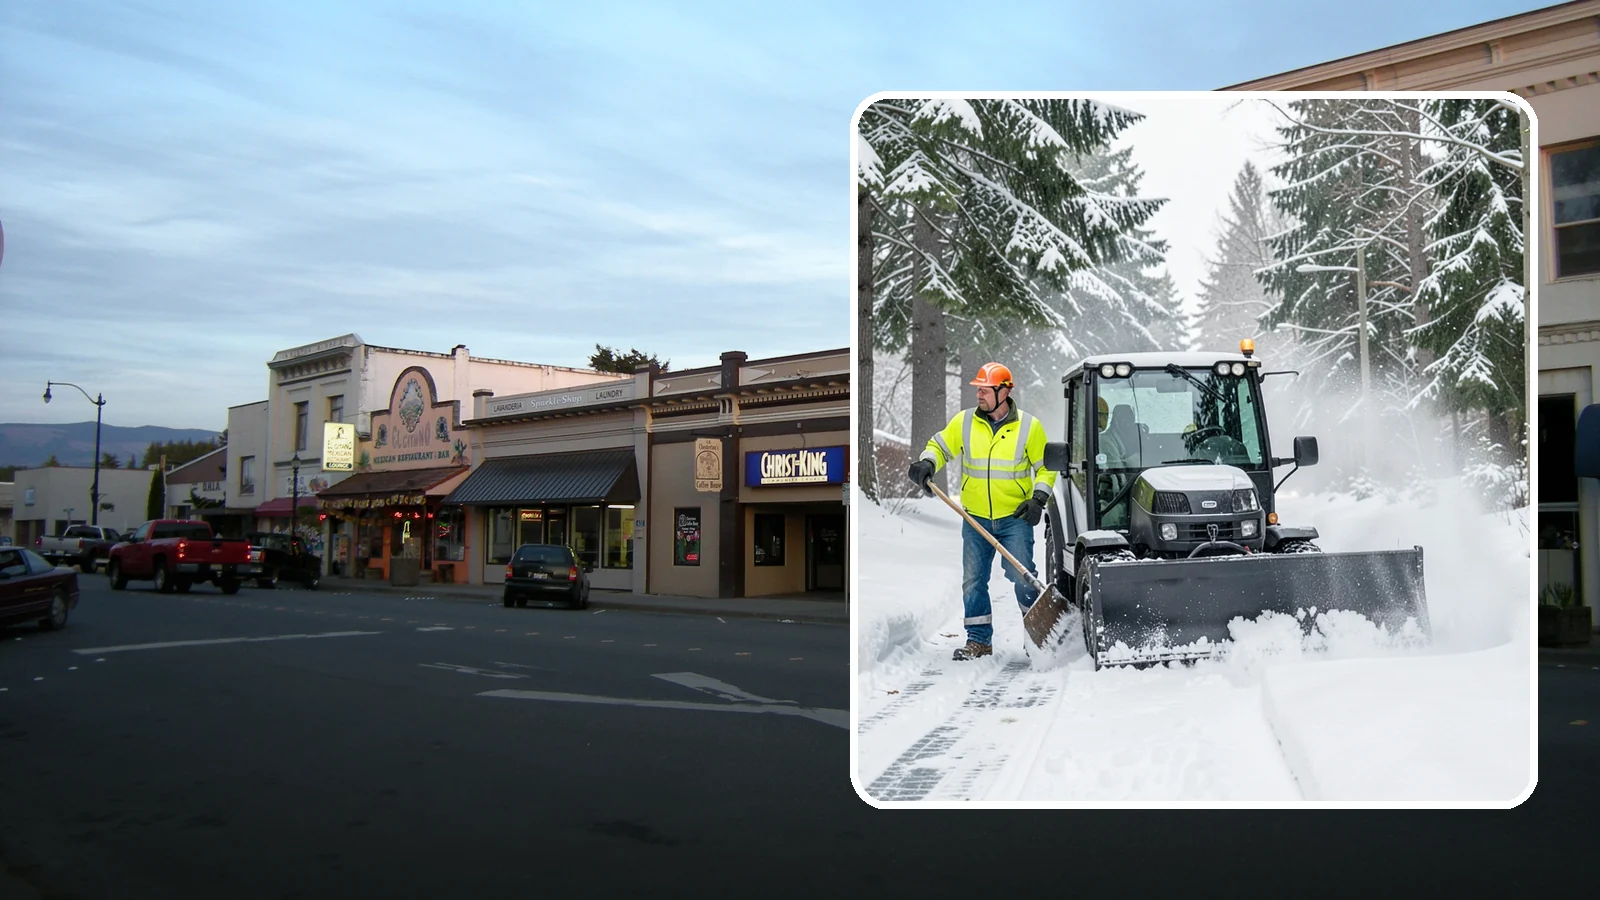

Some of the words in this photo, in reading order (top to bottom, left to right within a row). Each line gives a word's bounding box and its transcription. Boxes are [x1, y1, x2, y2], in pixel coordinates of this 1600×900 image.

[595, 389, 623, 400] LAUNDRY
[493, 402, 523, 413] LAVANDERIA
[530, 396, 561, 409] Sparkle
[562, 394, 582, 406] Shop
[373, 456, 396, 464] MEXICAN
[397, 451, 433, 461] RESTAURANT
[437, 450, 450, 459] BAR
[761, 452, 797, 478] CHRIST
[799, 450, 827, 476] KING
[696, 480, 709, 489] Coffee
[710, 480, 722, 489] House
